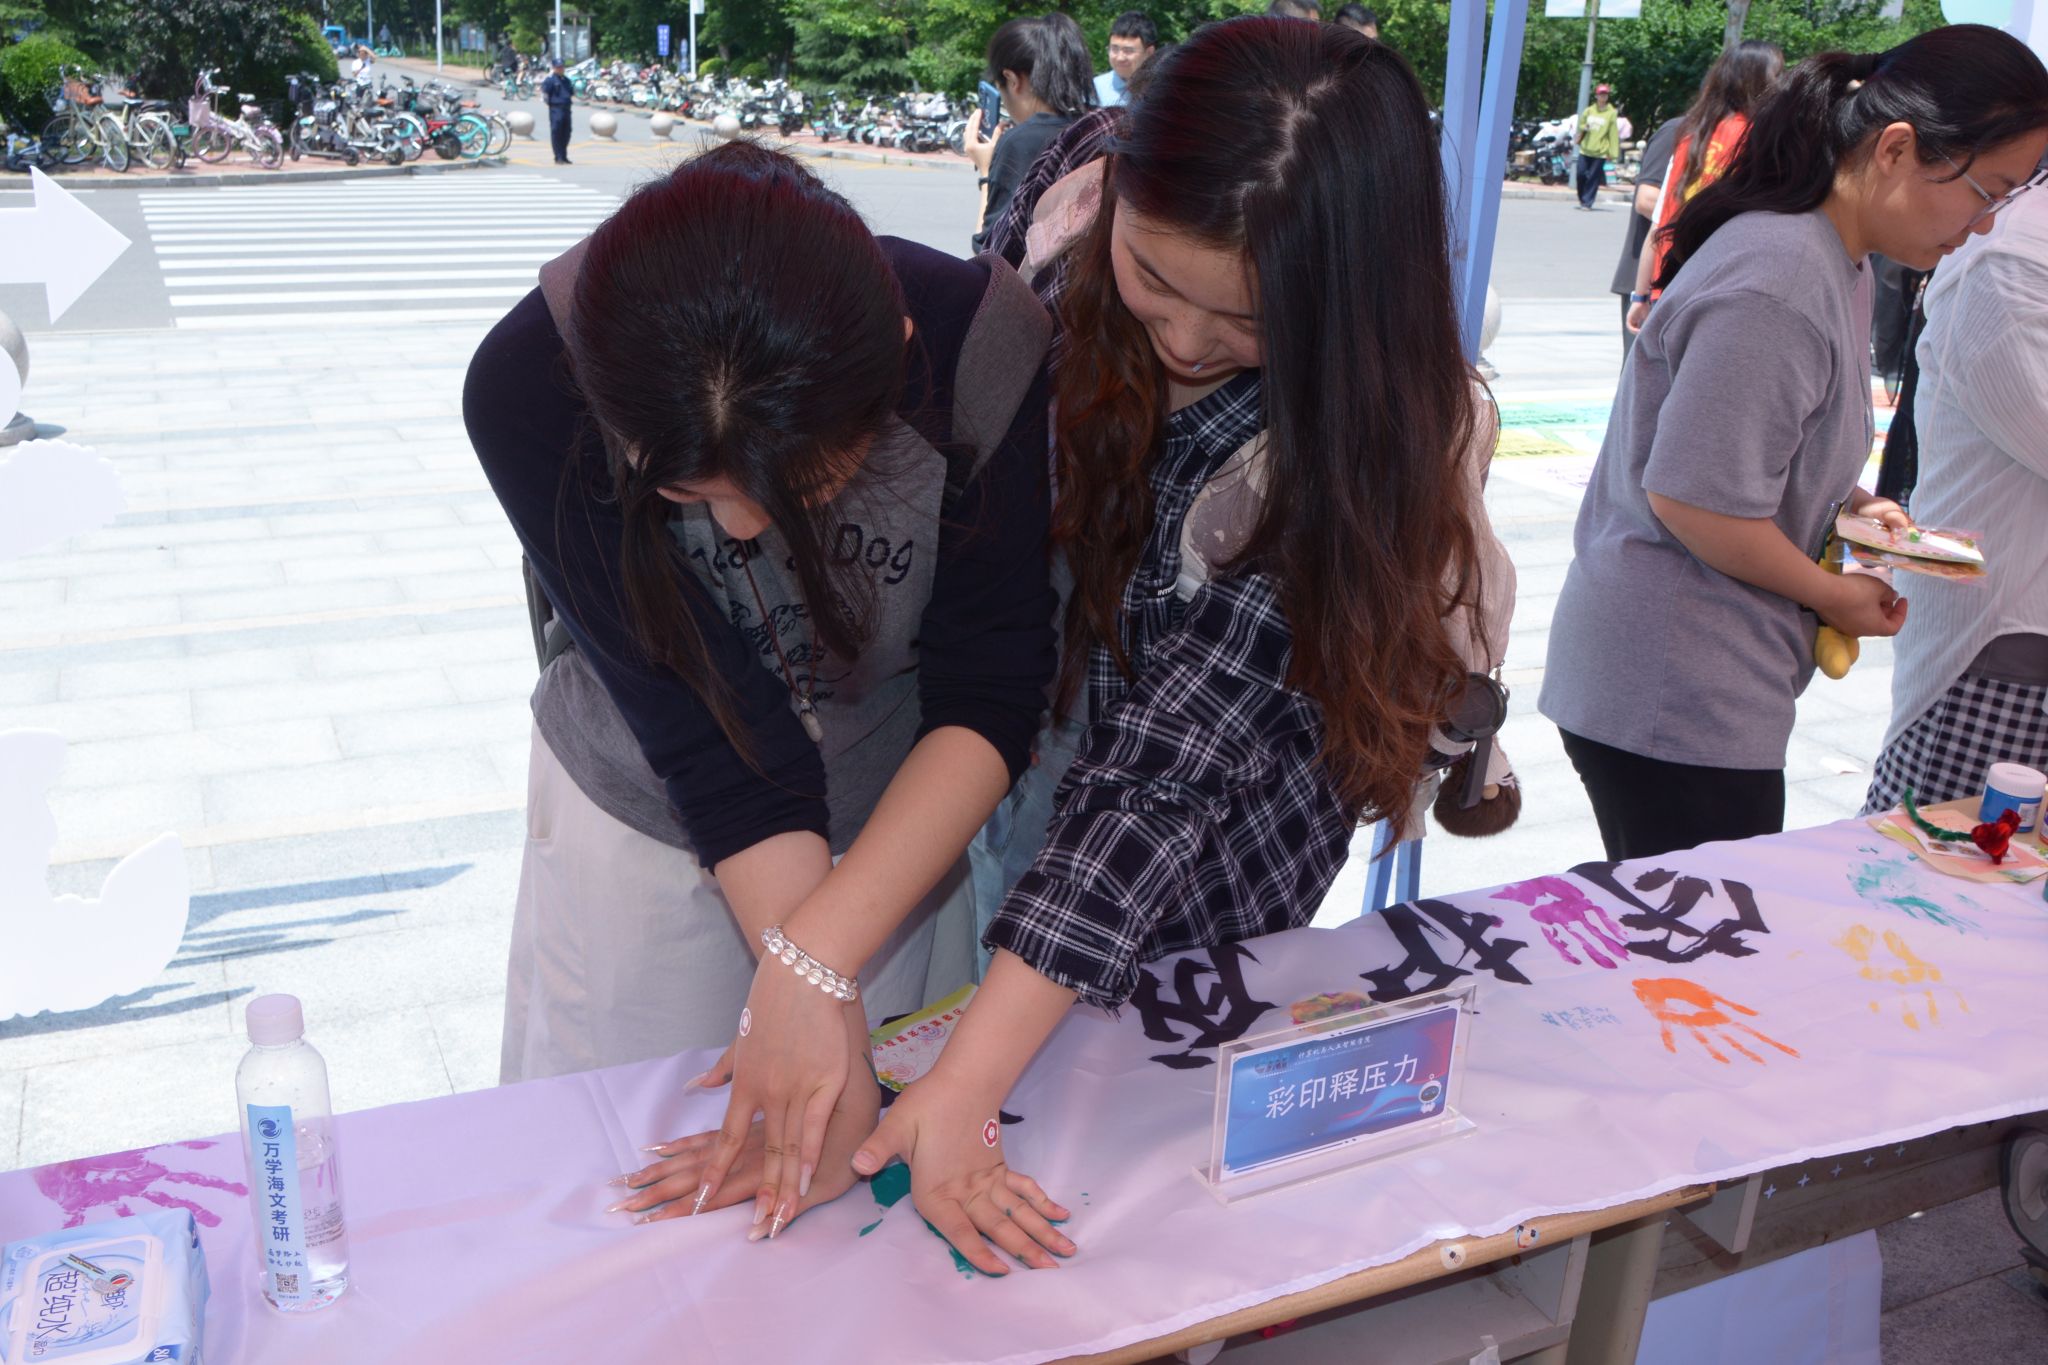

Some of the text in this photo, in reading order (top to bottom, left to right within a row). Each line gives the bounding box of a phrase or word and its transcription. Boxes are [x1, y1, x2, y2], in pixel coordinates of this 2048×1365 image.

[831, 523, 914, 585] Dog
[1265, 1055, 1418, 1119] 彩印释压力
[262, 1143, 291, 1243] 万学海文考研
[35, 1270, 82, 1340] 超纯水
